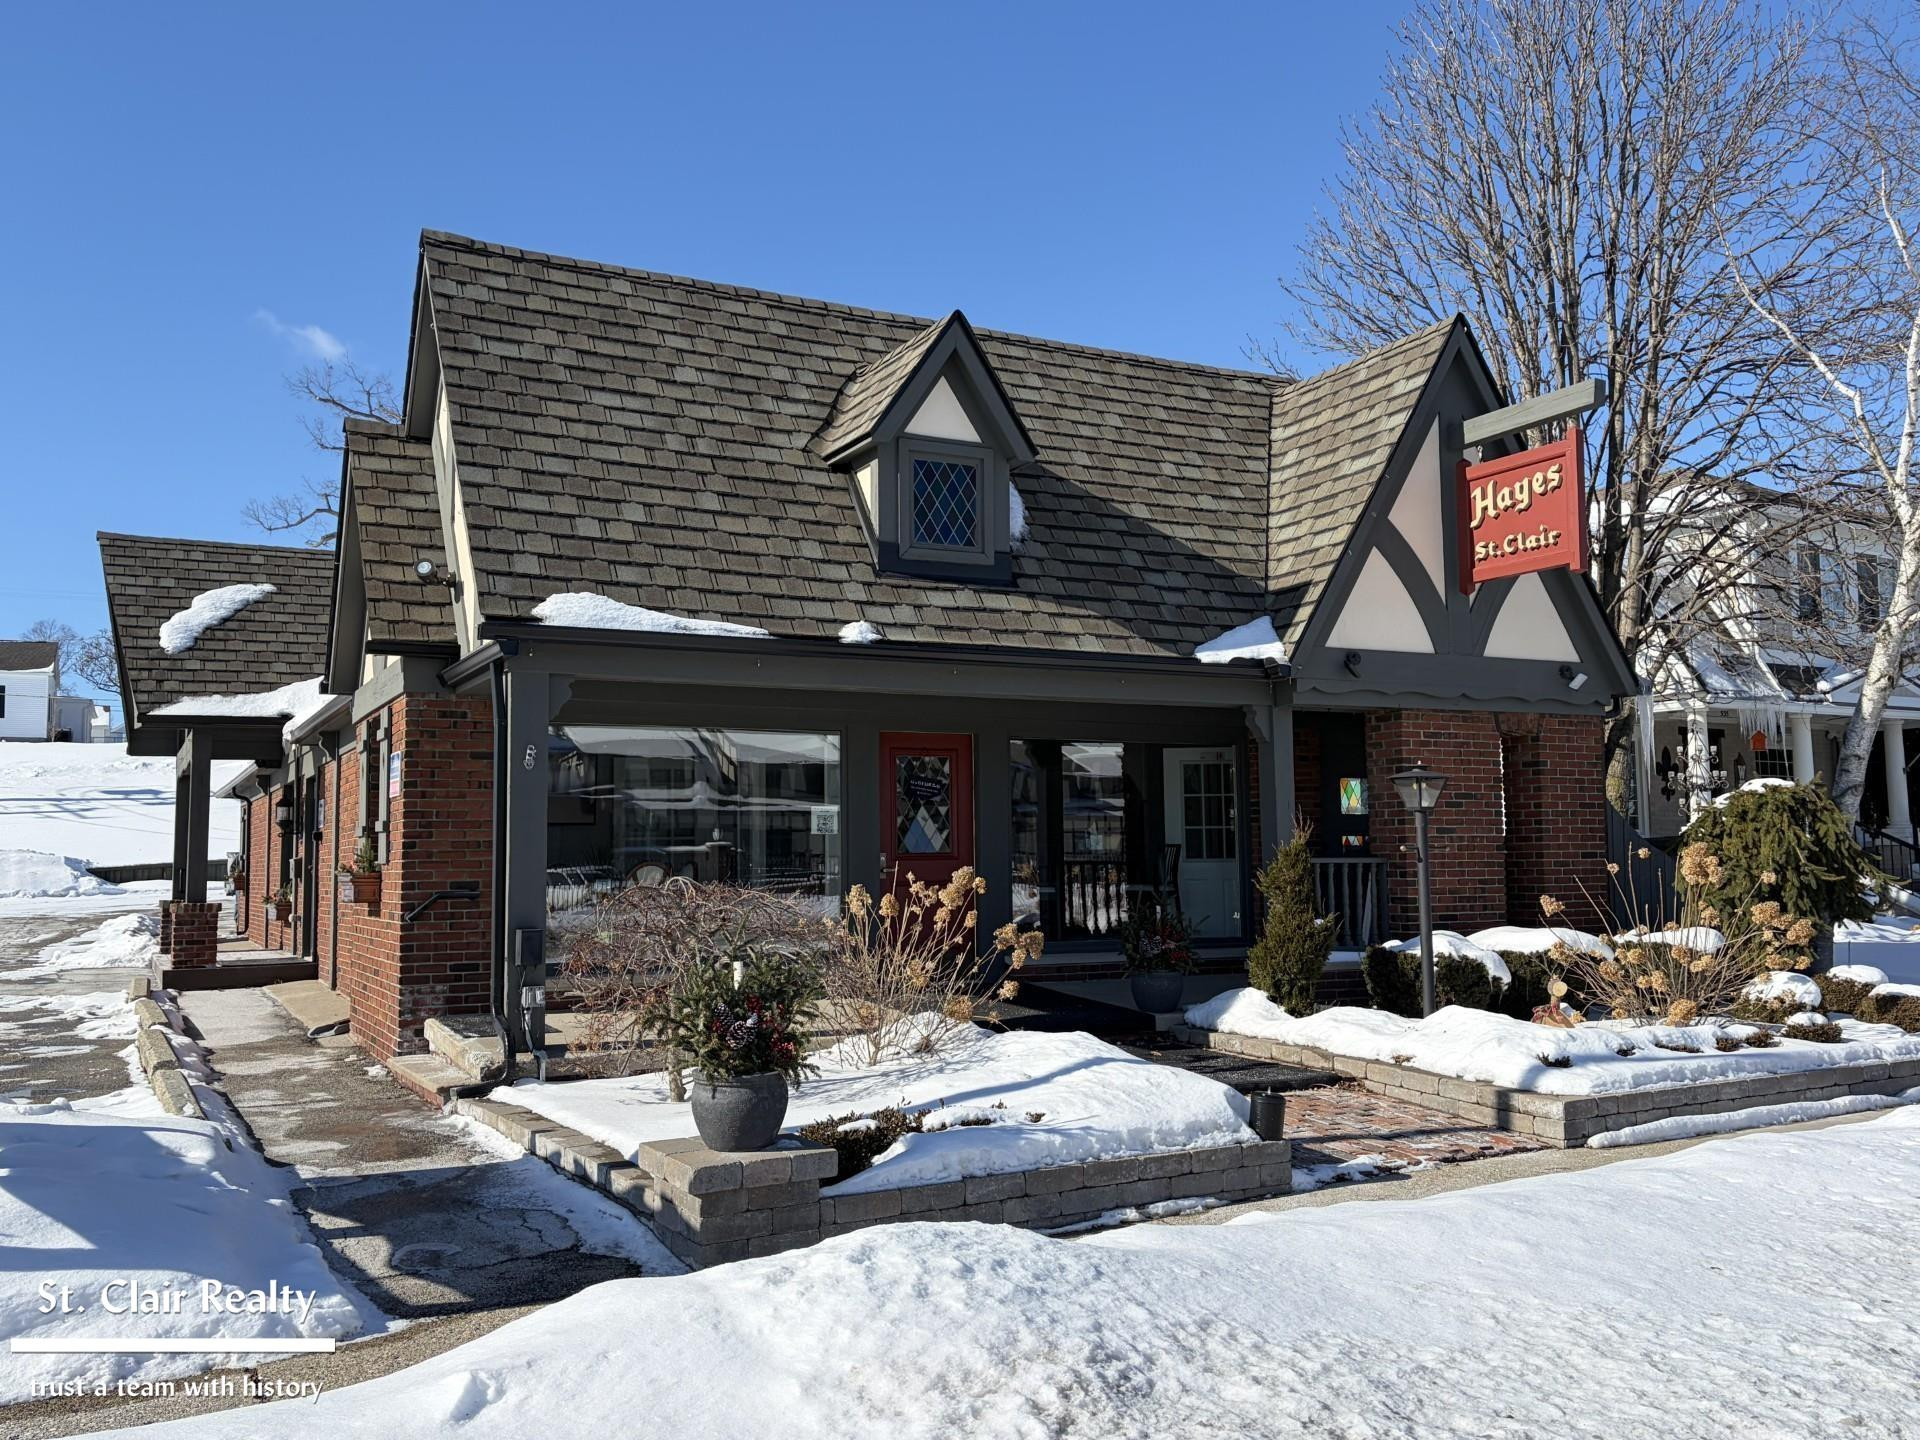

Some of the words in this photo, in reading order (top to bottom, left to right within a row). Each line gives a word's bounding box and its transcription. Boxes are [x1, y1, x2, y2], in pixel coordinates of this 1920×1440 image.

[1470, 463, 1562, 528] Hayes
[1475, 541, 1505, 561] St.
[1503, 524, 1561, 555] Clair
